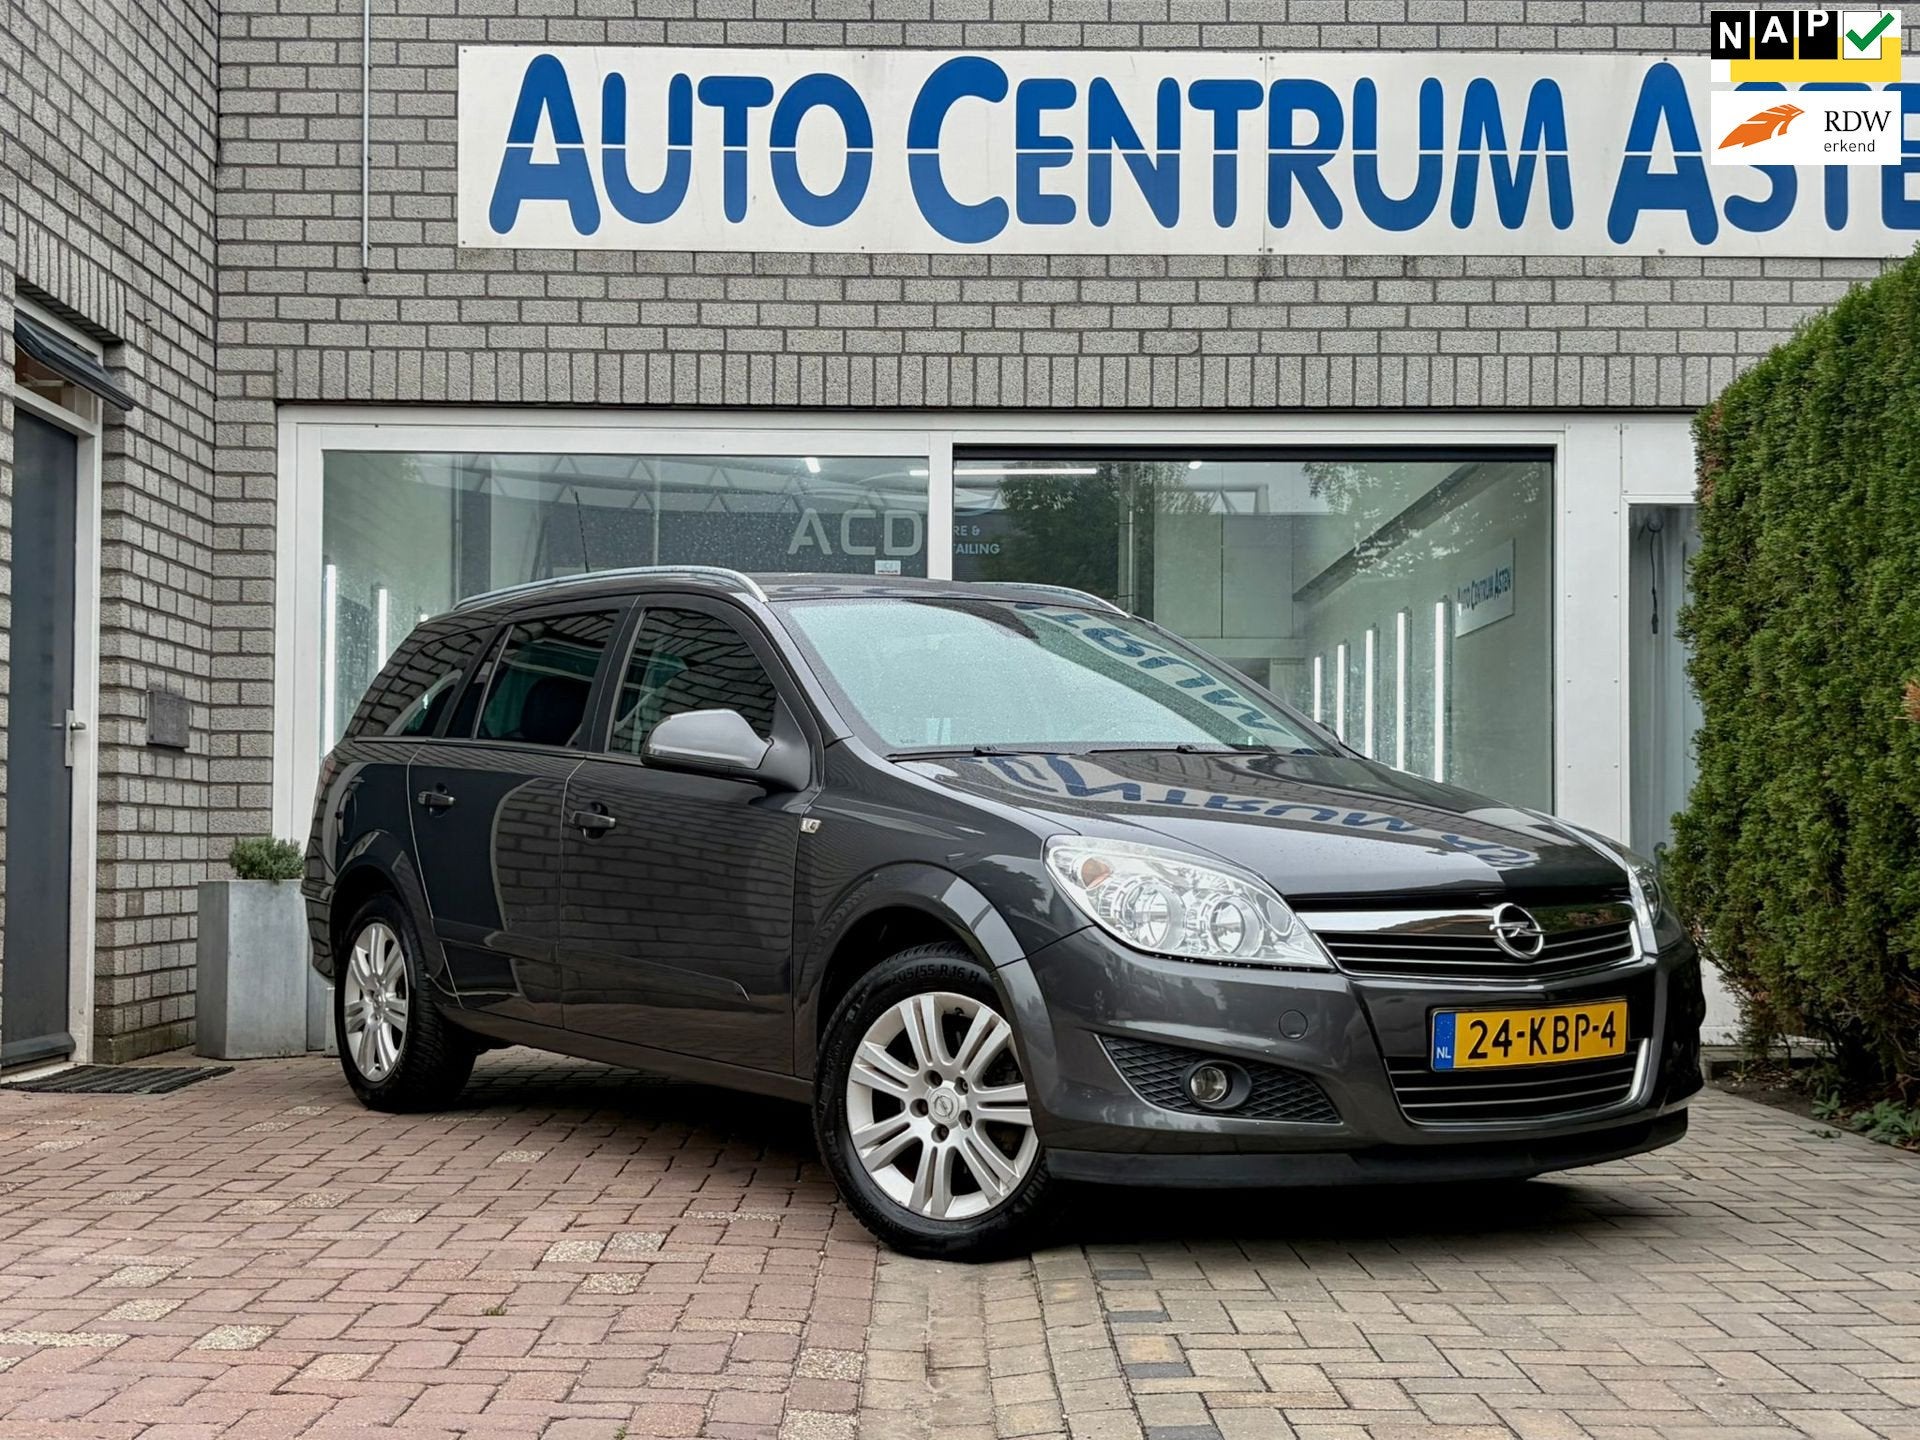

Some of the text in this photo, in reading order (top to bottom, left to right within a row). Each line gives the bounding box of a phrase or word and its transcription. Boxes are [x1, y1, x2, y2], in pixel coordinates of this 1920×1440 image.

[489, 53, 874, 236] AUTO
[907, 56, 1574, 244] CENTRUM
[787, 508, 923, 556] ACD
[972, 525, 980, 536] &
[953, 543, 1001, 555] AILING
[1467, 1010, 1617, 1061] 24-KBP-4
[1436, 1046, 1452, 1059] NL
